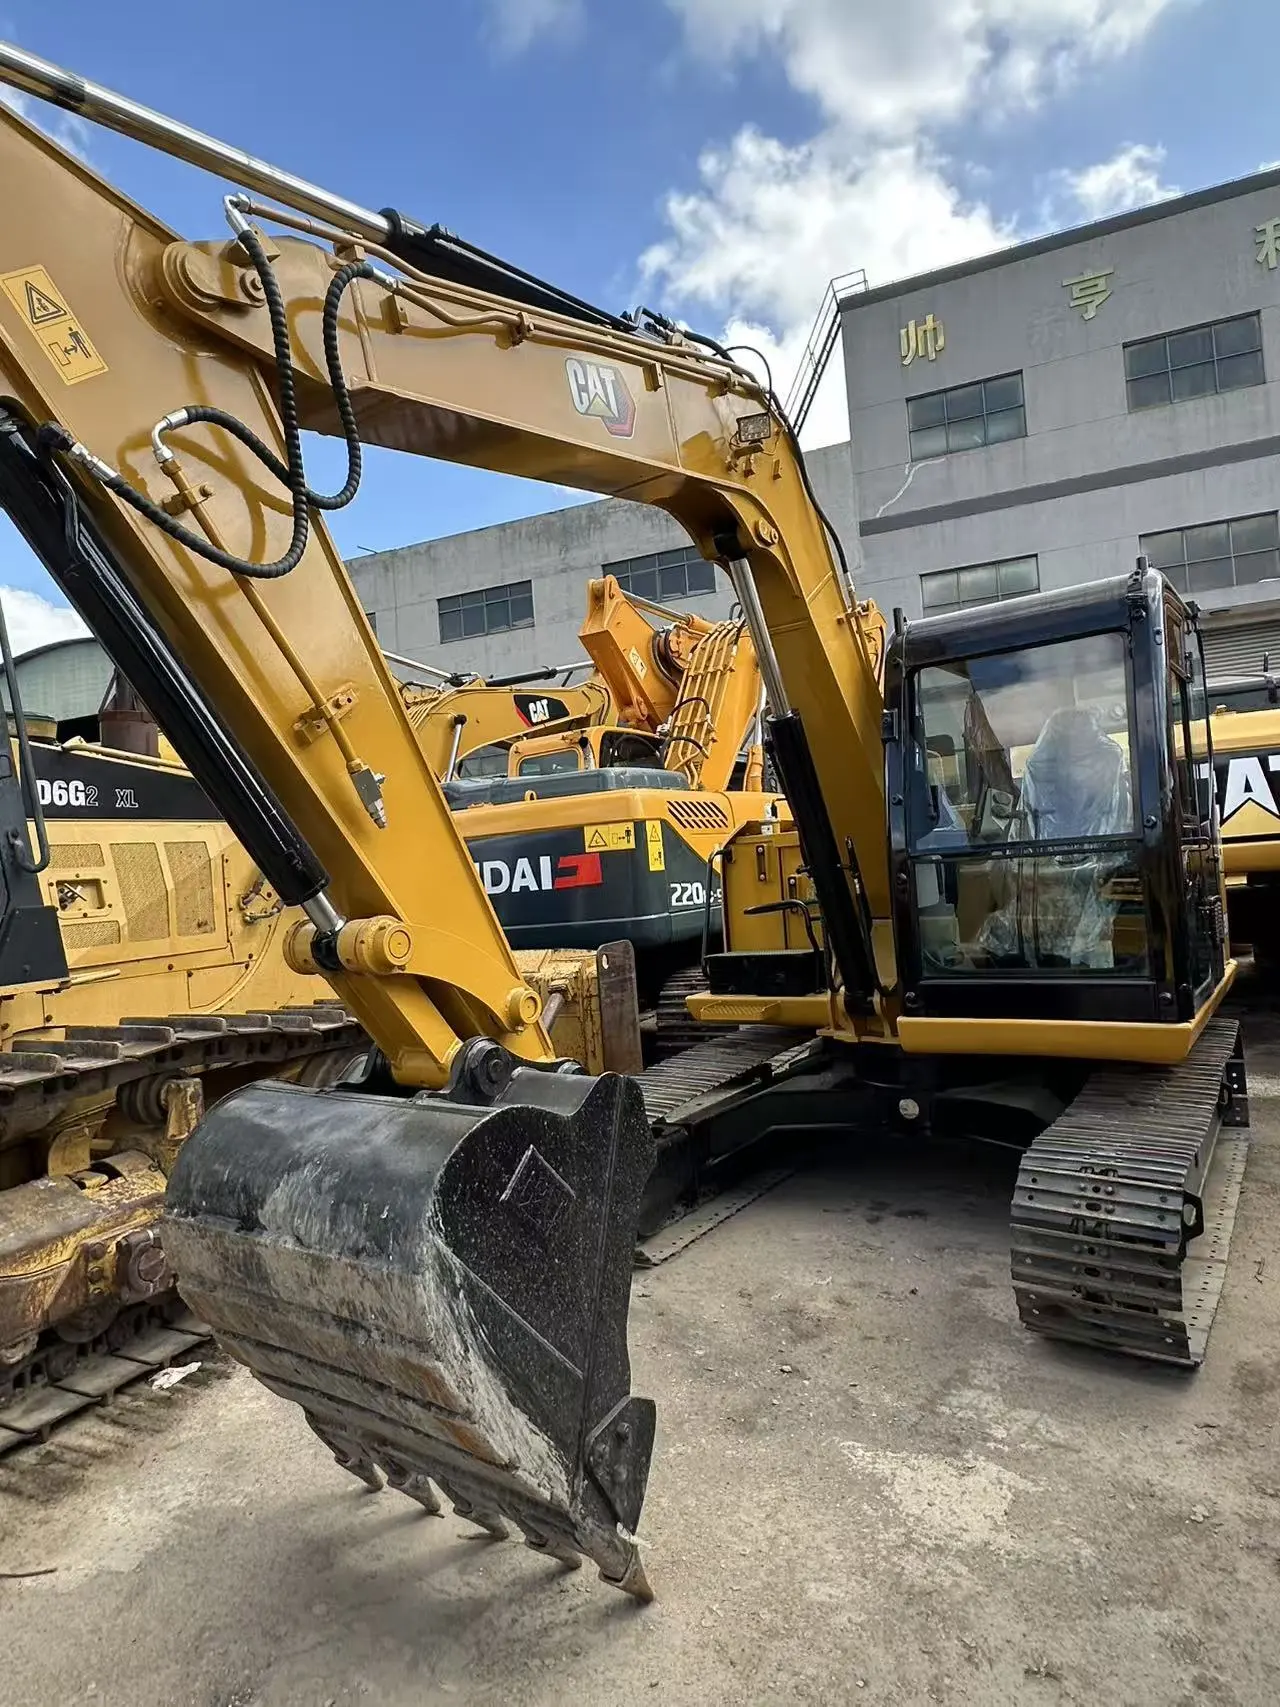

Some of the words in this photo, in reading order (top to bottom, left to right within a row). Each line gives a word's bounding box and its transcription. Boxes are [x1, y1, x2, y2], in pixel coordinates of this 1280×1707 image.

[900, 313, 945, 366] 帅
[1061, 267, 1114, 321] 亨
[566, 358, 619, 416] CAT
[528, 698, 550, 723] CAT
[35, 779, 99, 807] D6G2
[115, 788, 139, 808] XL
[473, 855, 553, 895] DAI
